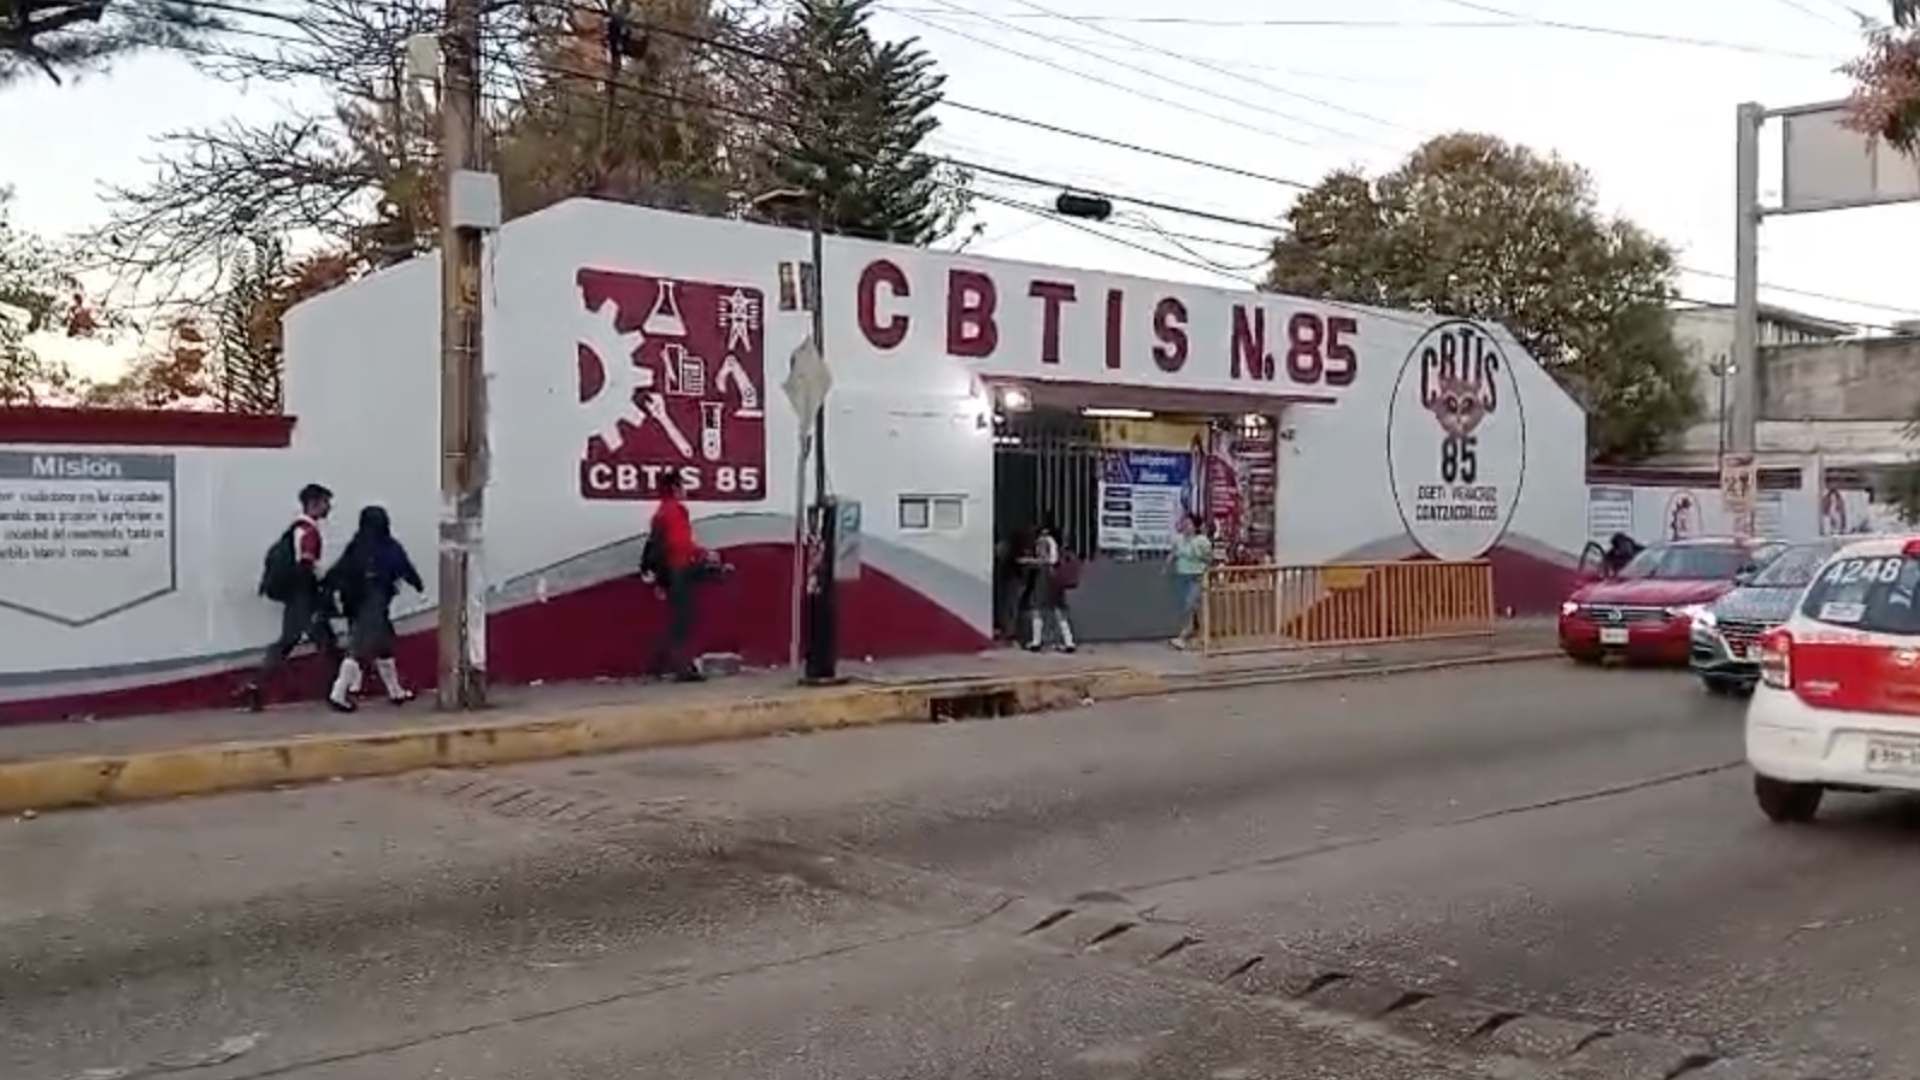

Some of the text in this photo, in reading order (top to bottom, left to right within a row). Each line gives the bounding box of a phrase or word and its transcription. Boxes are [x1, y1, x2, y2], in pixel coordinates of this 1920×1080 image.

[857, 259, 1189, 373] CBTIS
[32, 455, 122, 477] Misión
[1441, 437, 1477, 483] 85
[716, 466, 759, 491] 85
[1825, 558, 1902, 584] 4248
